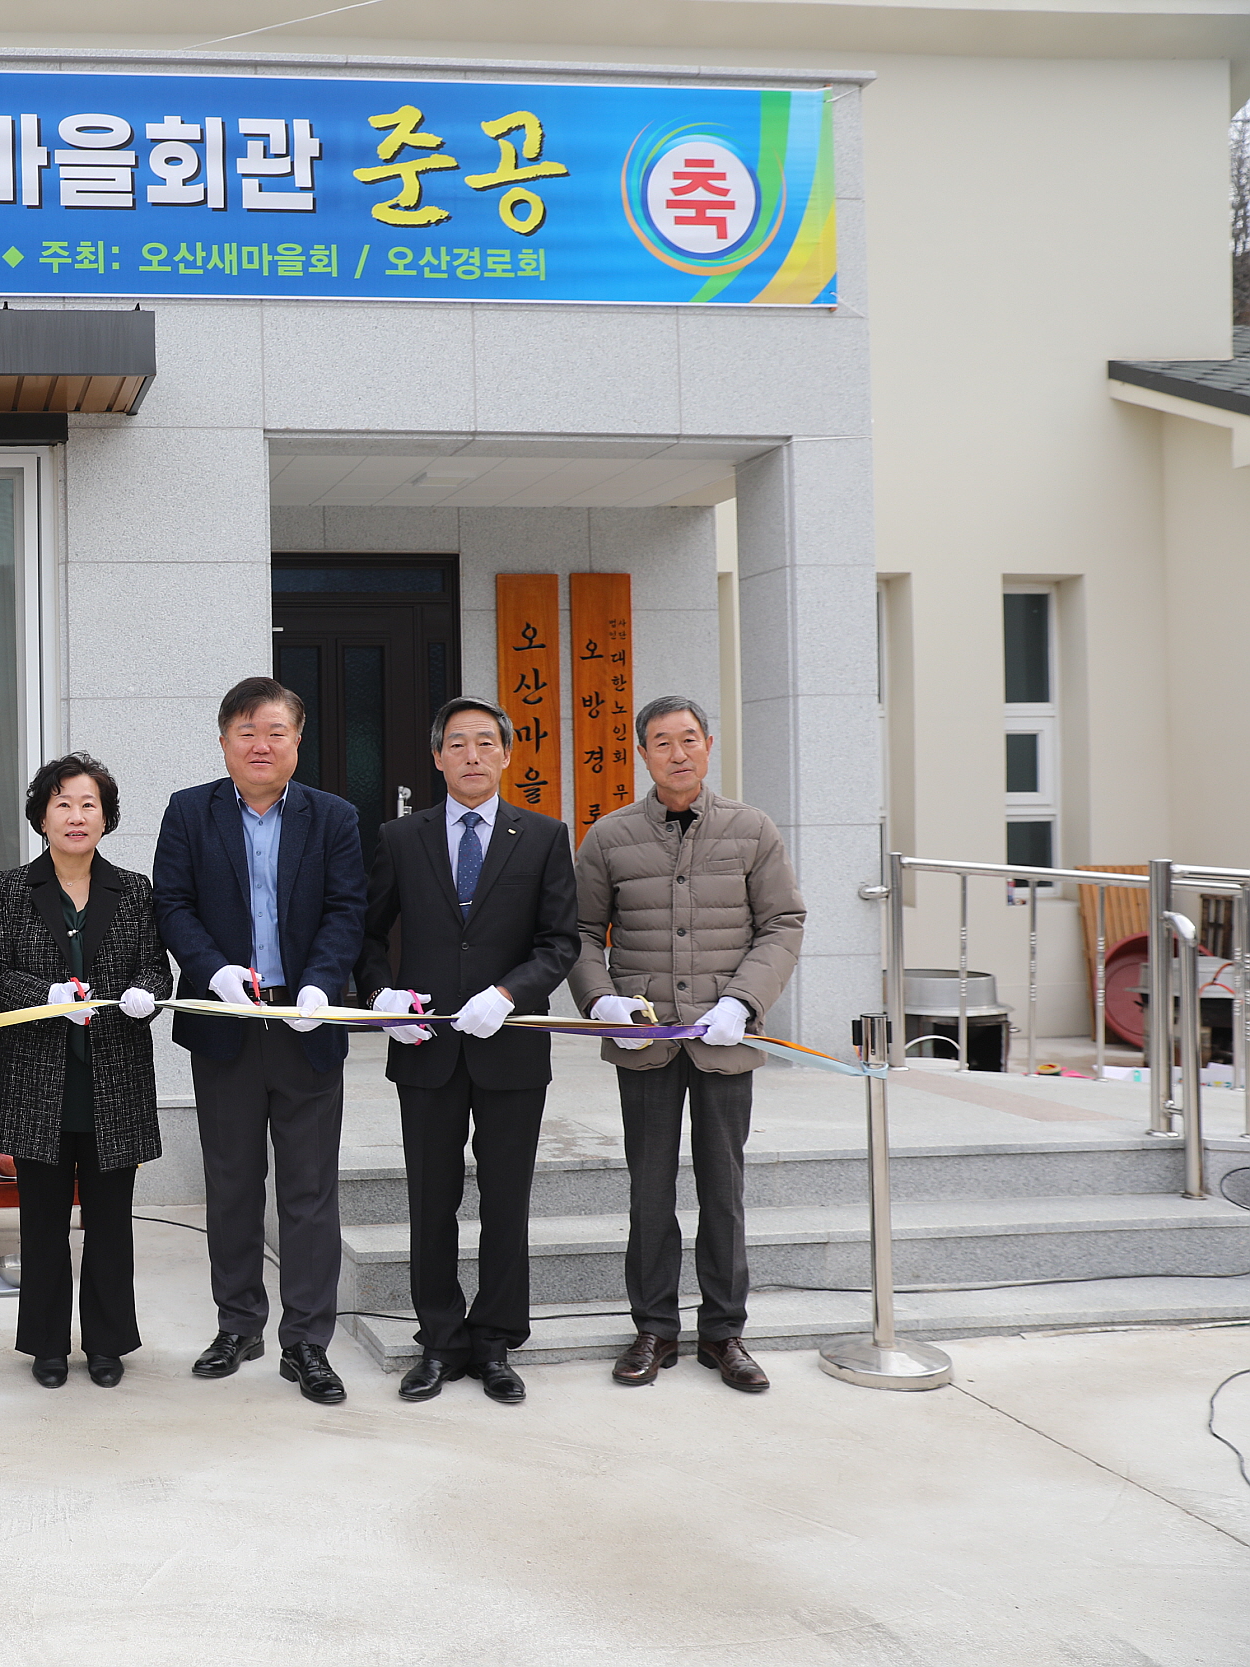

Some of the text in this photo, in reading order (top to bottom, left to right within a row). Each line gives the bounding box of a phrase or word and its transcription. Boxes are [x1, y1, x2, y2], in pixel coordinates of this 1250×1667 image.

[354, 106, 569, 235] 준공
[665, 158, 735, 240] 축
[39, 240, 120, 275] 주최:
[139, 242, 338, 277] 오산새마을회
[385, 246, 546, 281] 오산경로회
[512, 621, 548, 804] 오산마을
